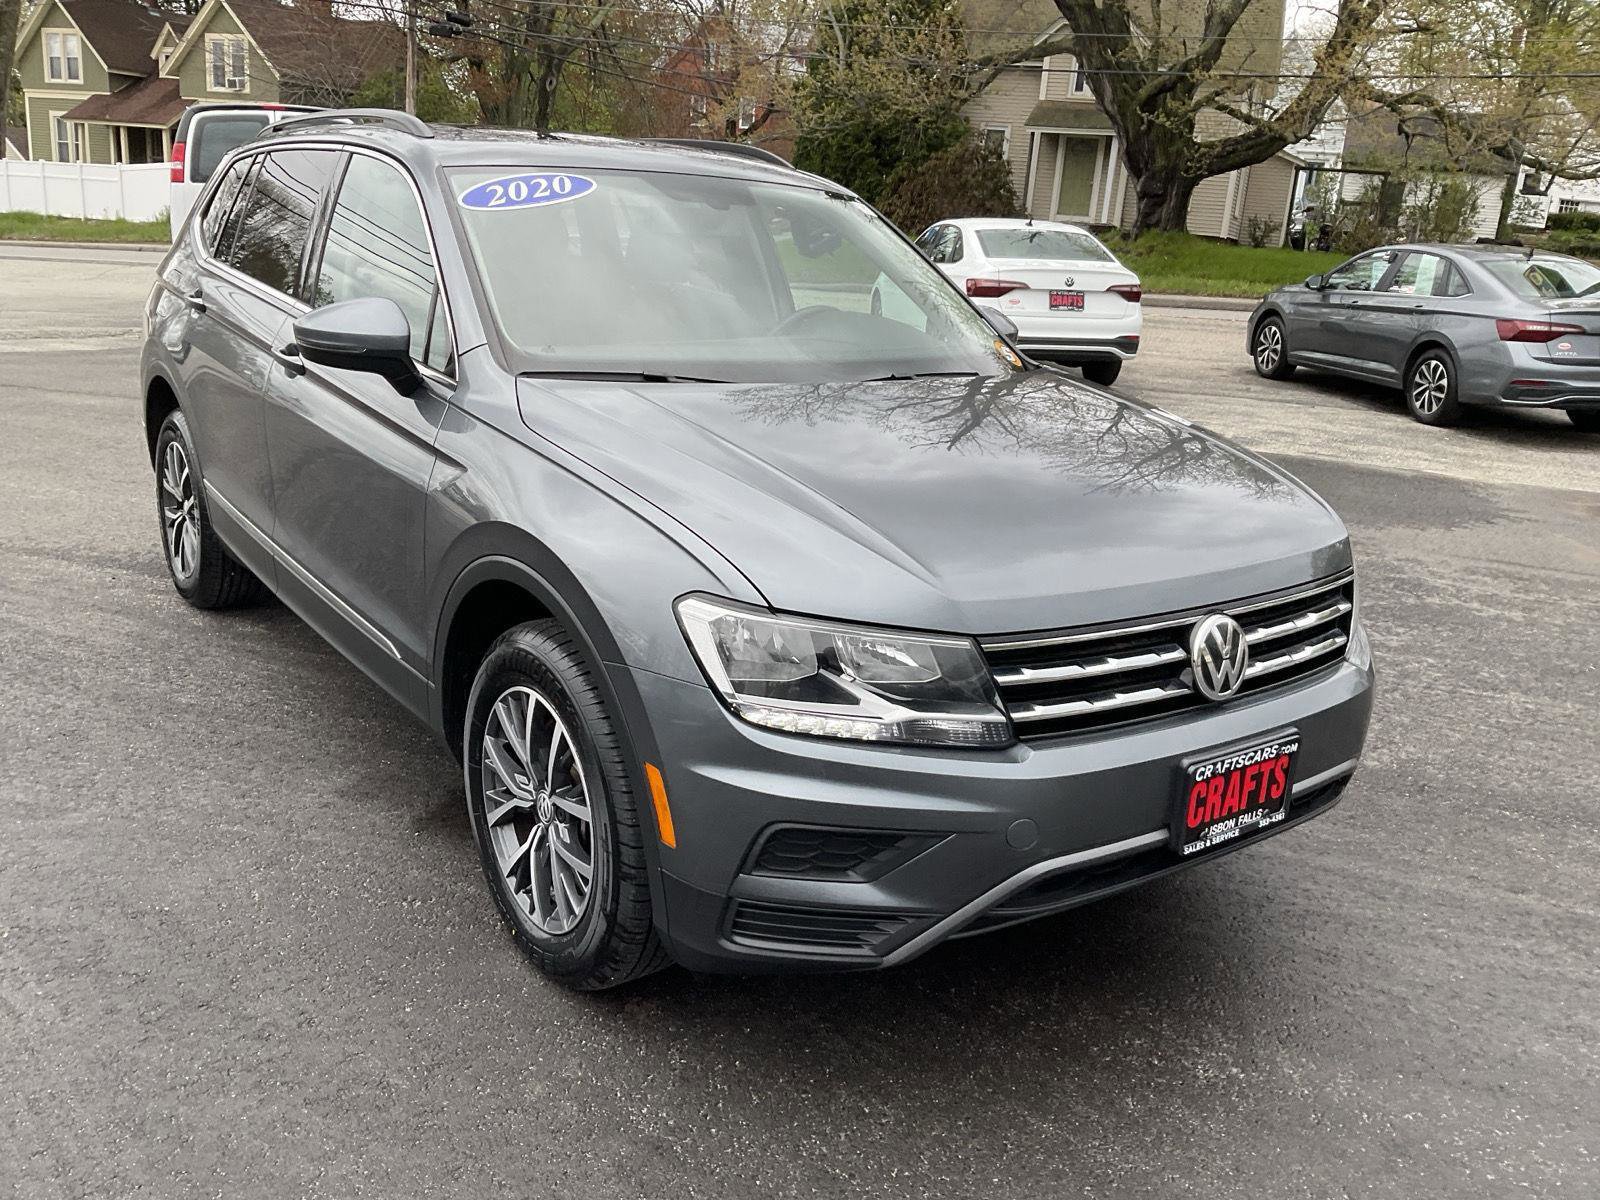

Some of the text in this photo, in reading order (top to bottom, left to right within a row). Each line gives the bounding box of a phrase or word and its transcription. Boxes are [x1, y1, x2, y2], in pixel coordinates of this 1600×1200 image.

[485, 176, 572, 207] 2020
[1051, 295, 1083, 307] CRAFTS
[1195, 743, 1299, 782] CRAFTSCARSCOM
[1187, 755, 1290, 829] CRAFTS
[1238, 808, 1263, 826] FALLS
[1183, 839, 1205, 855] SALES
[1211, 828, 1240, 845] SERVICE
